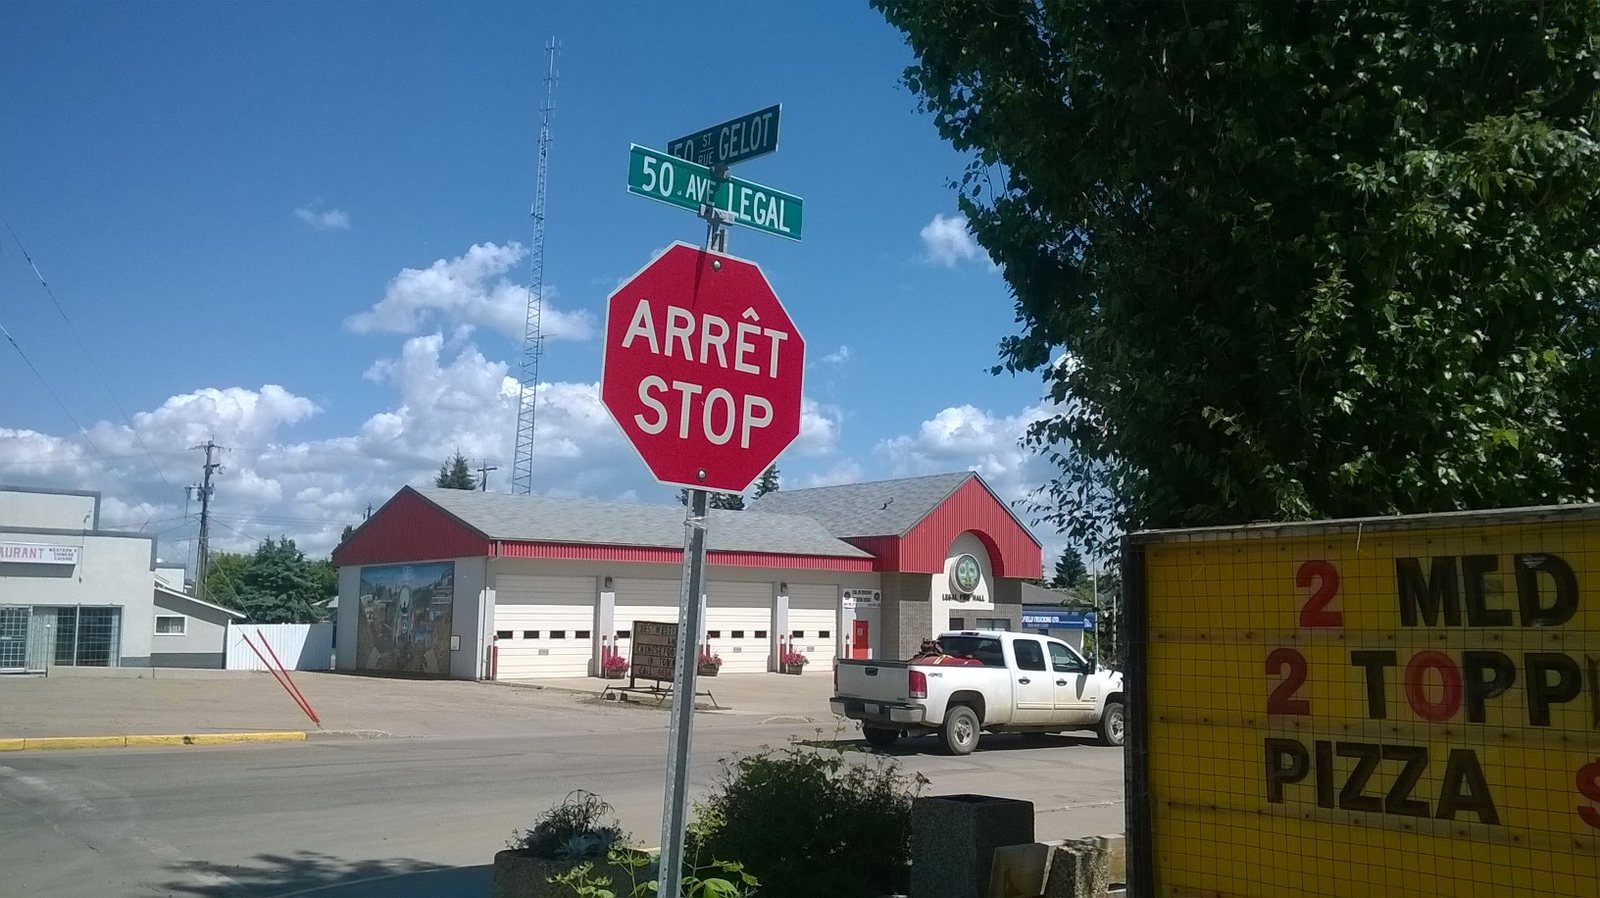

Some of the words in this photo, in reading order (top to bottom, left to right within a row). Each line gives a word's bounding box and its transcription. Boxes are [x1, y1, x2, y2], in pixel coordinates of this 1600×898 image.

[698, 152, 713, 165] RUE
[702, 132, 712, 147] ST
[719, 113, 772, 161] GELOT
[642, 156, 674, 197] 50
[685, 174, 716, 206] AVE
[728, 183, 790, 232] LEGAL
[621, 299, 788, 379] ARRÊT
[634, 375, 774, 449] STOP
[941, 593, 957, 601] LEGAL
[972, 594, 985, 602] HALL
[1296, 559, 1343, 628] 2
[1395, 553, 1580, 628] MED
[1264, 647, 1310, 717] 2
[1264, 737, 1501, 826] PIZZA
